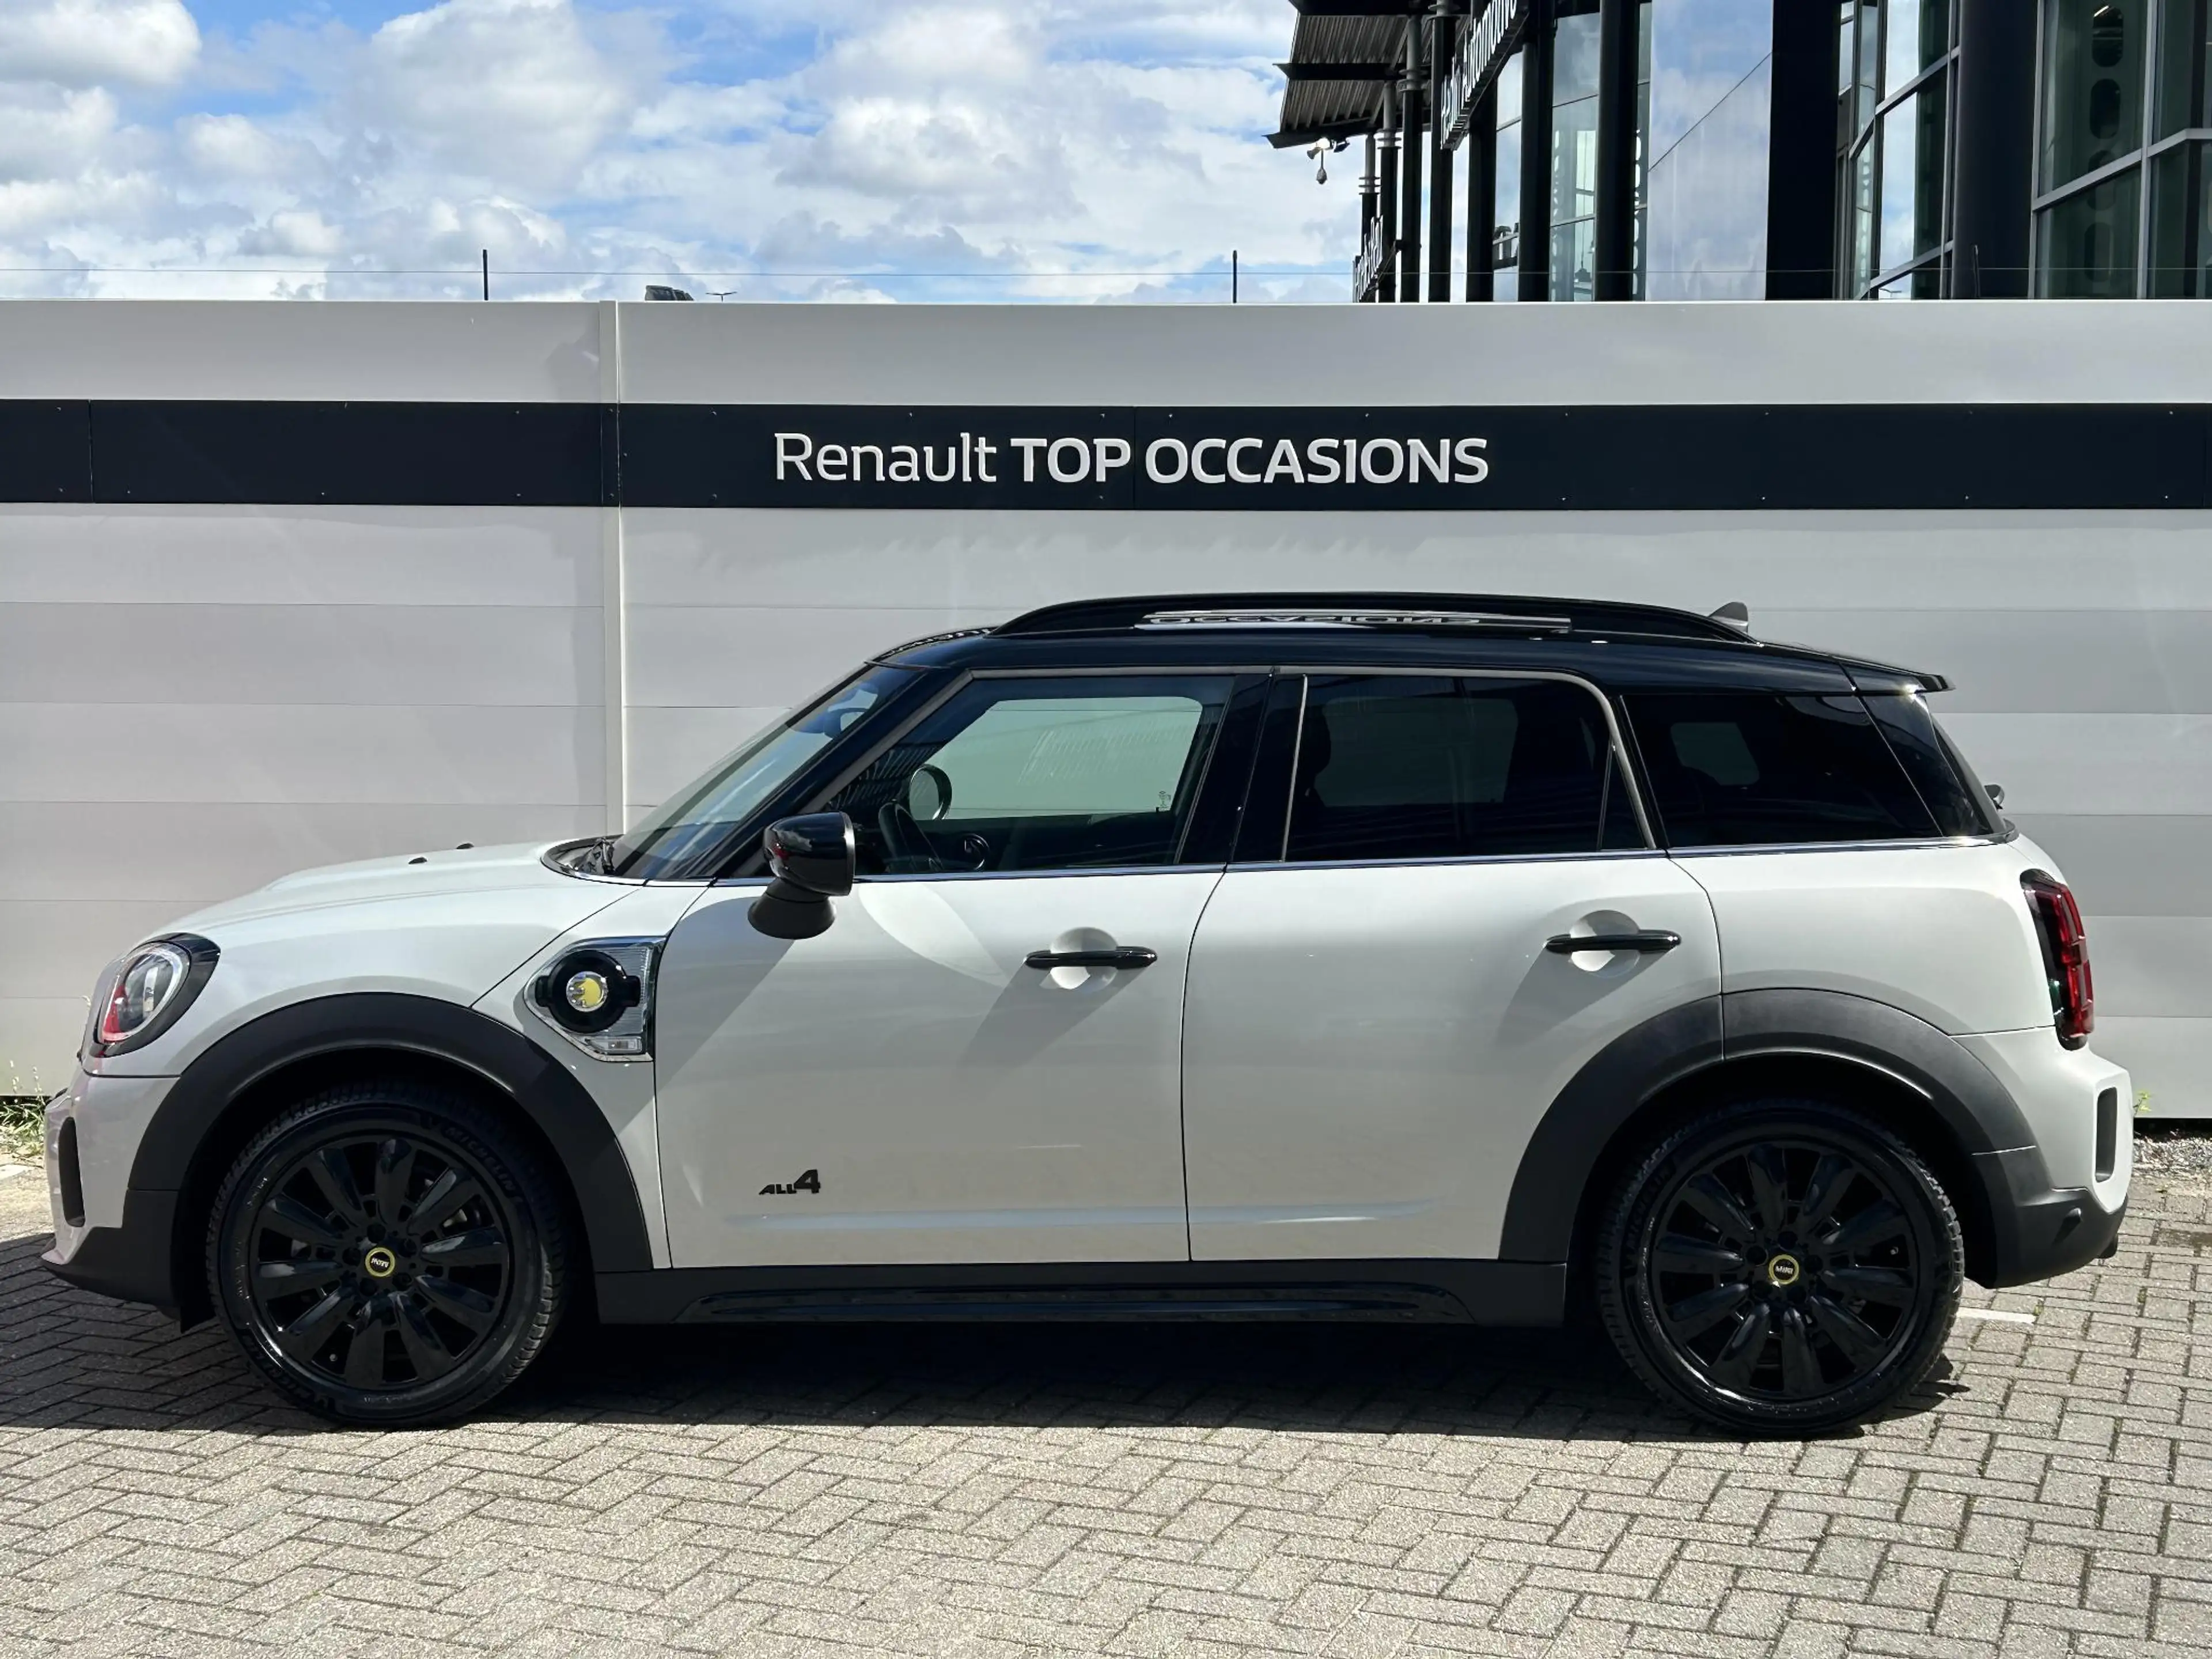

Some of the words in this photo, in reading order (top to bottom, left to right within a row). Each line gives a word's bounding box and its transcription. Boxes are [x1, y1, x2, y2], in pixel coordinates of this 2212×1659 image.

[774, 433, 997, 483] Renault
[1010, 438, 1131, 483] TOP
[1145, 437, 1488, 484] OCCASIONS
[759, 1169, 821, 1195] ALL4
